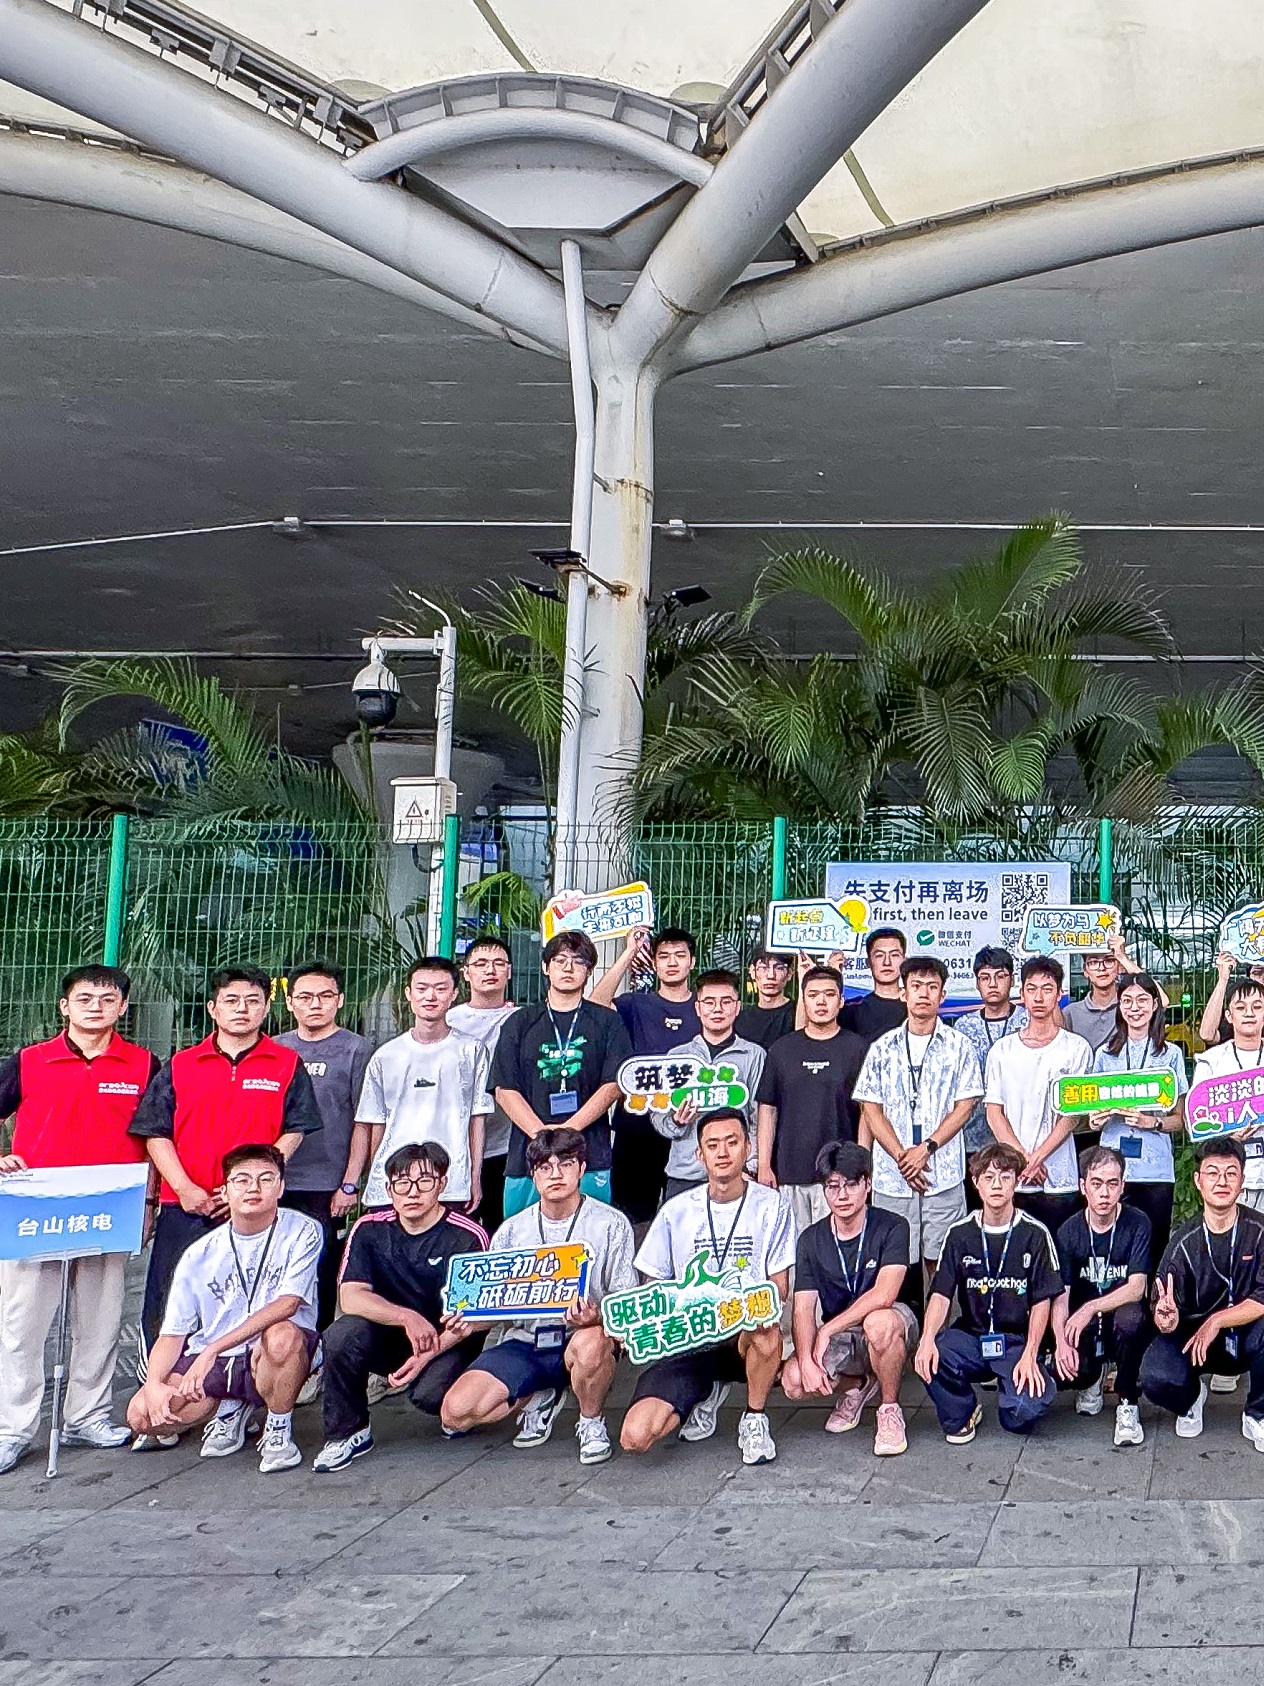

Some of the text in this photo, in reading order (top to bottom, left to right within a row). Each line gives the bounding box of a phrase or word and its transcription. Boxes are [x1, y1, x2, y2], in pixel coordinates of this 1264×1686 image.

[844, 879, 989, 904] 先支付再离场
[873, 907, 988, 922] first, then leave
[1033, 912, 1090, 929] 以梦为马
[938, 930, 972, 939] 微信支付
[634, 1064, 694, 1091] 筑梦
[687, 1086, 728, 1106] 山海
[18, 1212, 112, 1236] 台山核电
[459, 1252, 560, 1283] 不忘初心
[477, 1278, 579, 1309] 砥砺前行
[610, 1288, 668, 1328] 驱动
[631, 1290, 773, 1354] 青春的梦想
